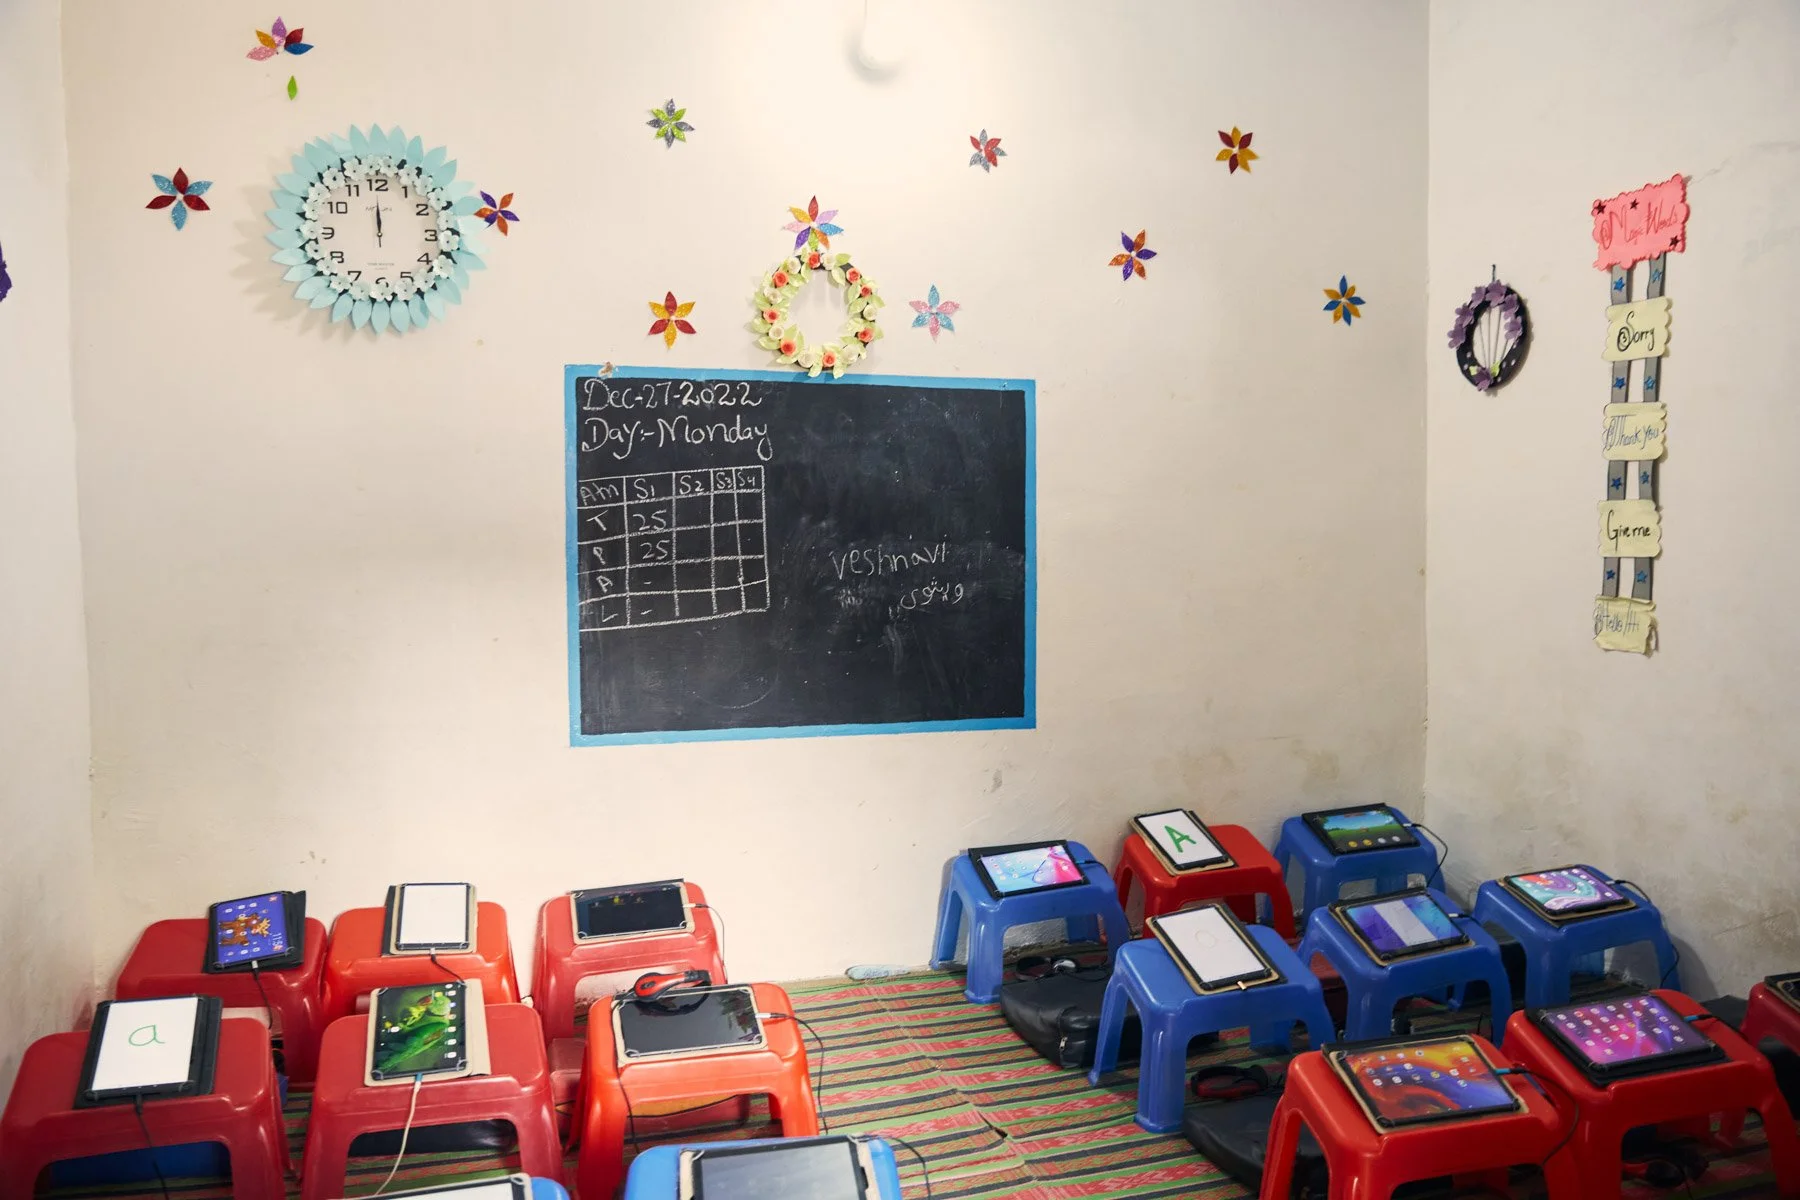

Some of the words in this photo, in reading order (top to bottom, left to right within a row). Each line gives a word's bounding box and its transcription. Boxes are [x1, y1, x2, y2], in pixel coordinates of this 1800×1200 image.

[345, 184, 360, 197] 11
[366, 178, 389, 192] 12
[401, 185, 409, 199] 1
[327, 201, 348, 214] 10
[415, 203, 430, 217] 2
[321, 226, 335, 240] 9
[424, 229, 438, 242] 3
[330, 250, 345, 264] 8
[416, 252, 432, 265] 4
[347, 270, 362, 282] 7
[1617, 310, 1655, 352] Sorry
[583, 378, 762, 410] Dec-27-2022
[633, 478, 655, 500] S1
[679, 474, 705, 495] S2
[716, 472, 733, 489] S3
[737, 470, 755, 487] S4
[632, 509, 667, 532] 25
[640, 540, 670, 560] 25
[1164, 825, 1197, 853] A
